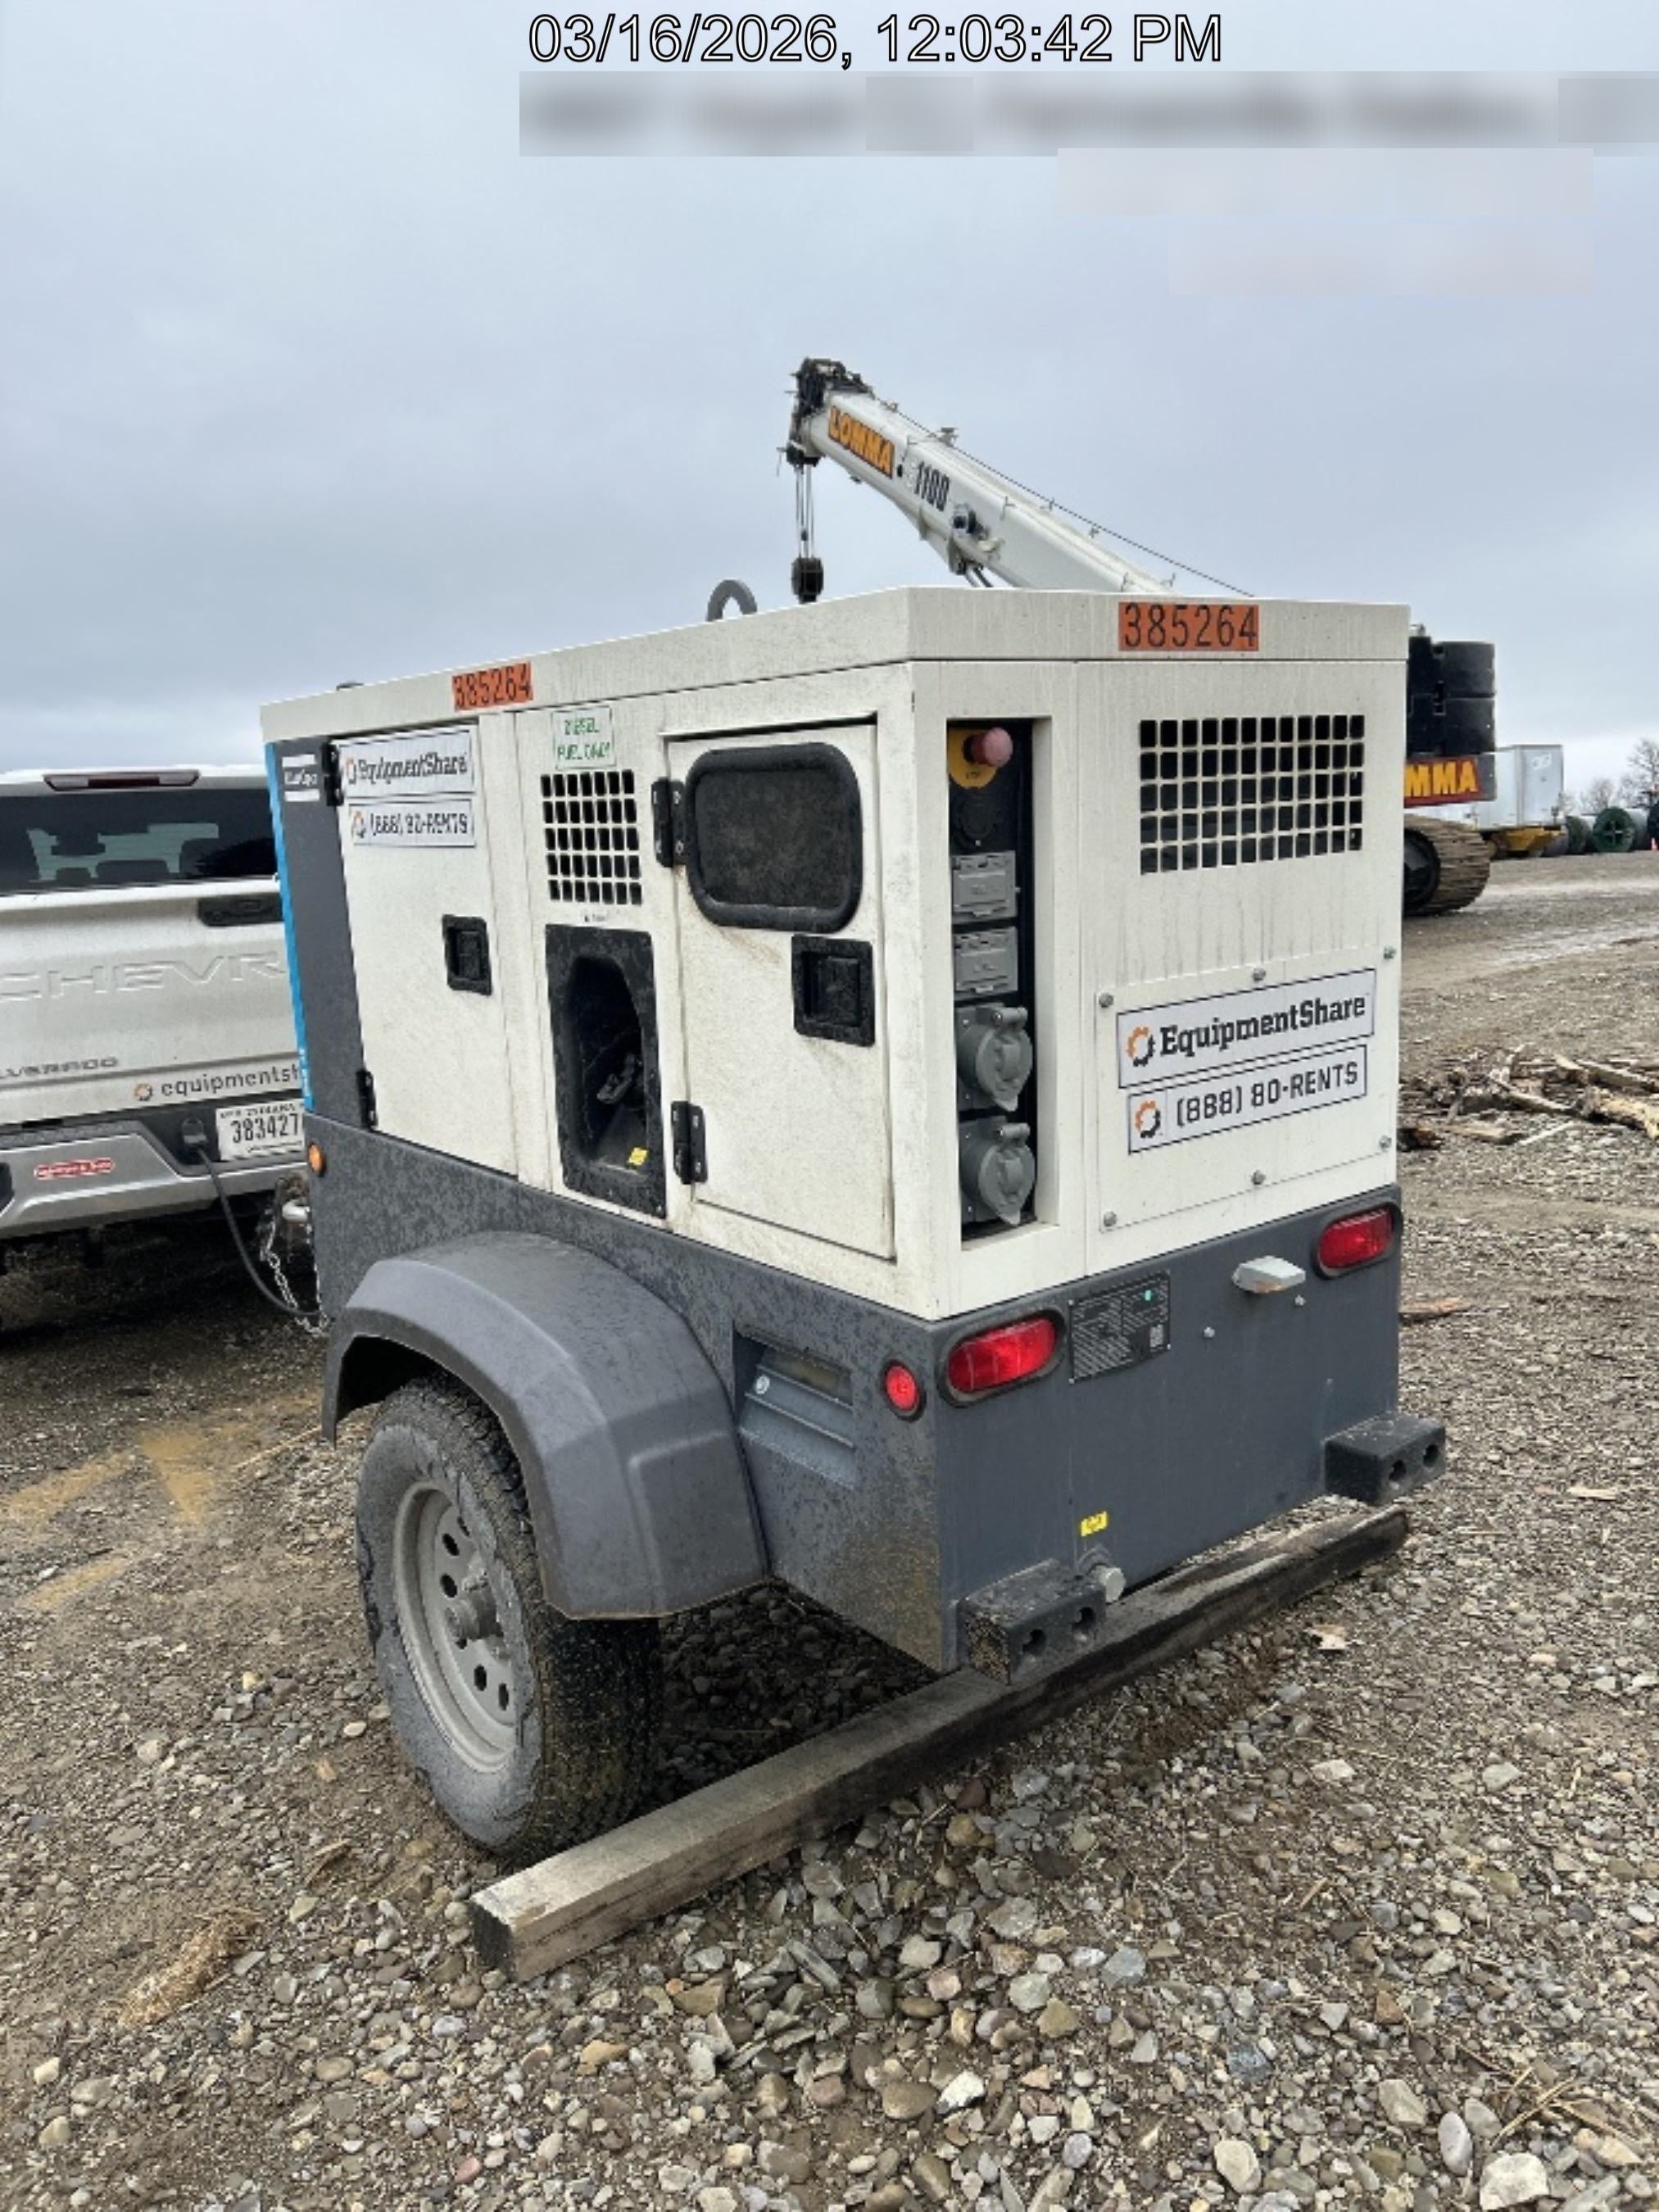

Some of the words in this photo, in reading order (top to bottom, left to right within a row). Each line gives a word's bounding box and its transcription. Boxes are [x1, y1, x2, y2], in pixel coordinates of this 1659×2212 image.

[829, 405, 894, 478] LOMMA
[914, 460, 950, 512] 1100
[1124, 602, 1258, 647] 385264
[452, 663, 531, 709] 385264
[357, 751, 468, 785] EquipmentShare
[1159, 996, 1367, 1058] EquipmentShare
[1176, 1086, 1242, 1127] (888)
[1251, 1061, 1358, 1108] 80-RENTS
[229, 1112, 298, 1145] 383427
